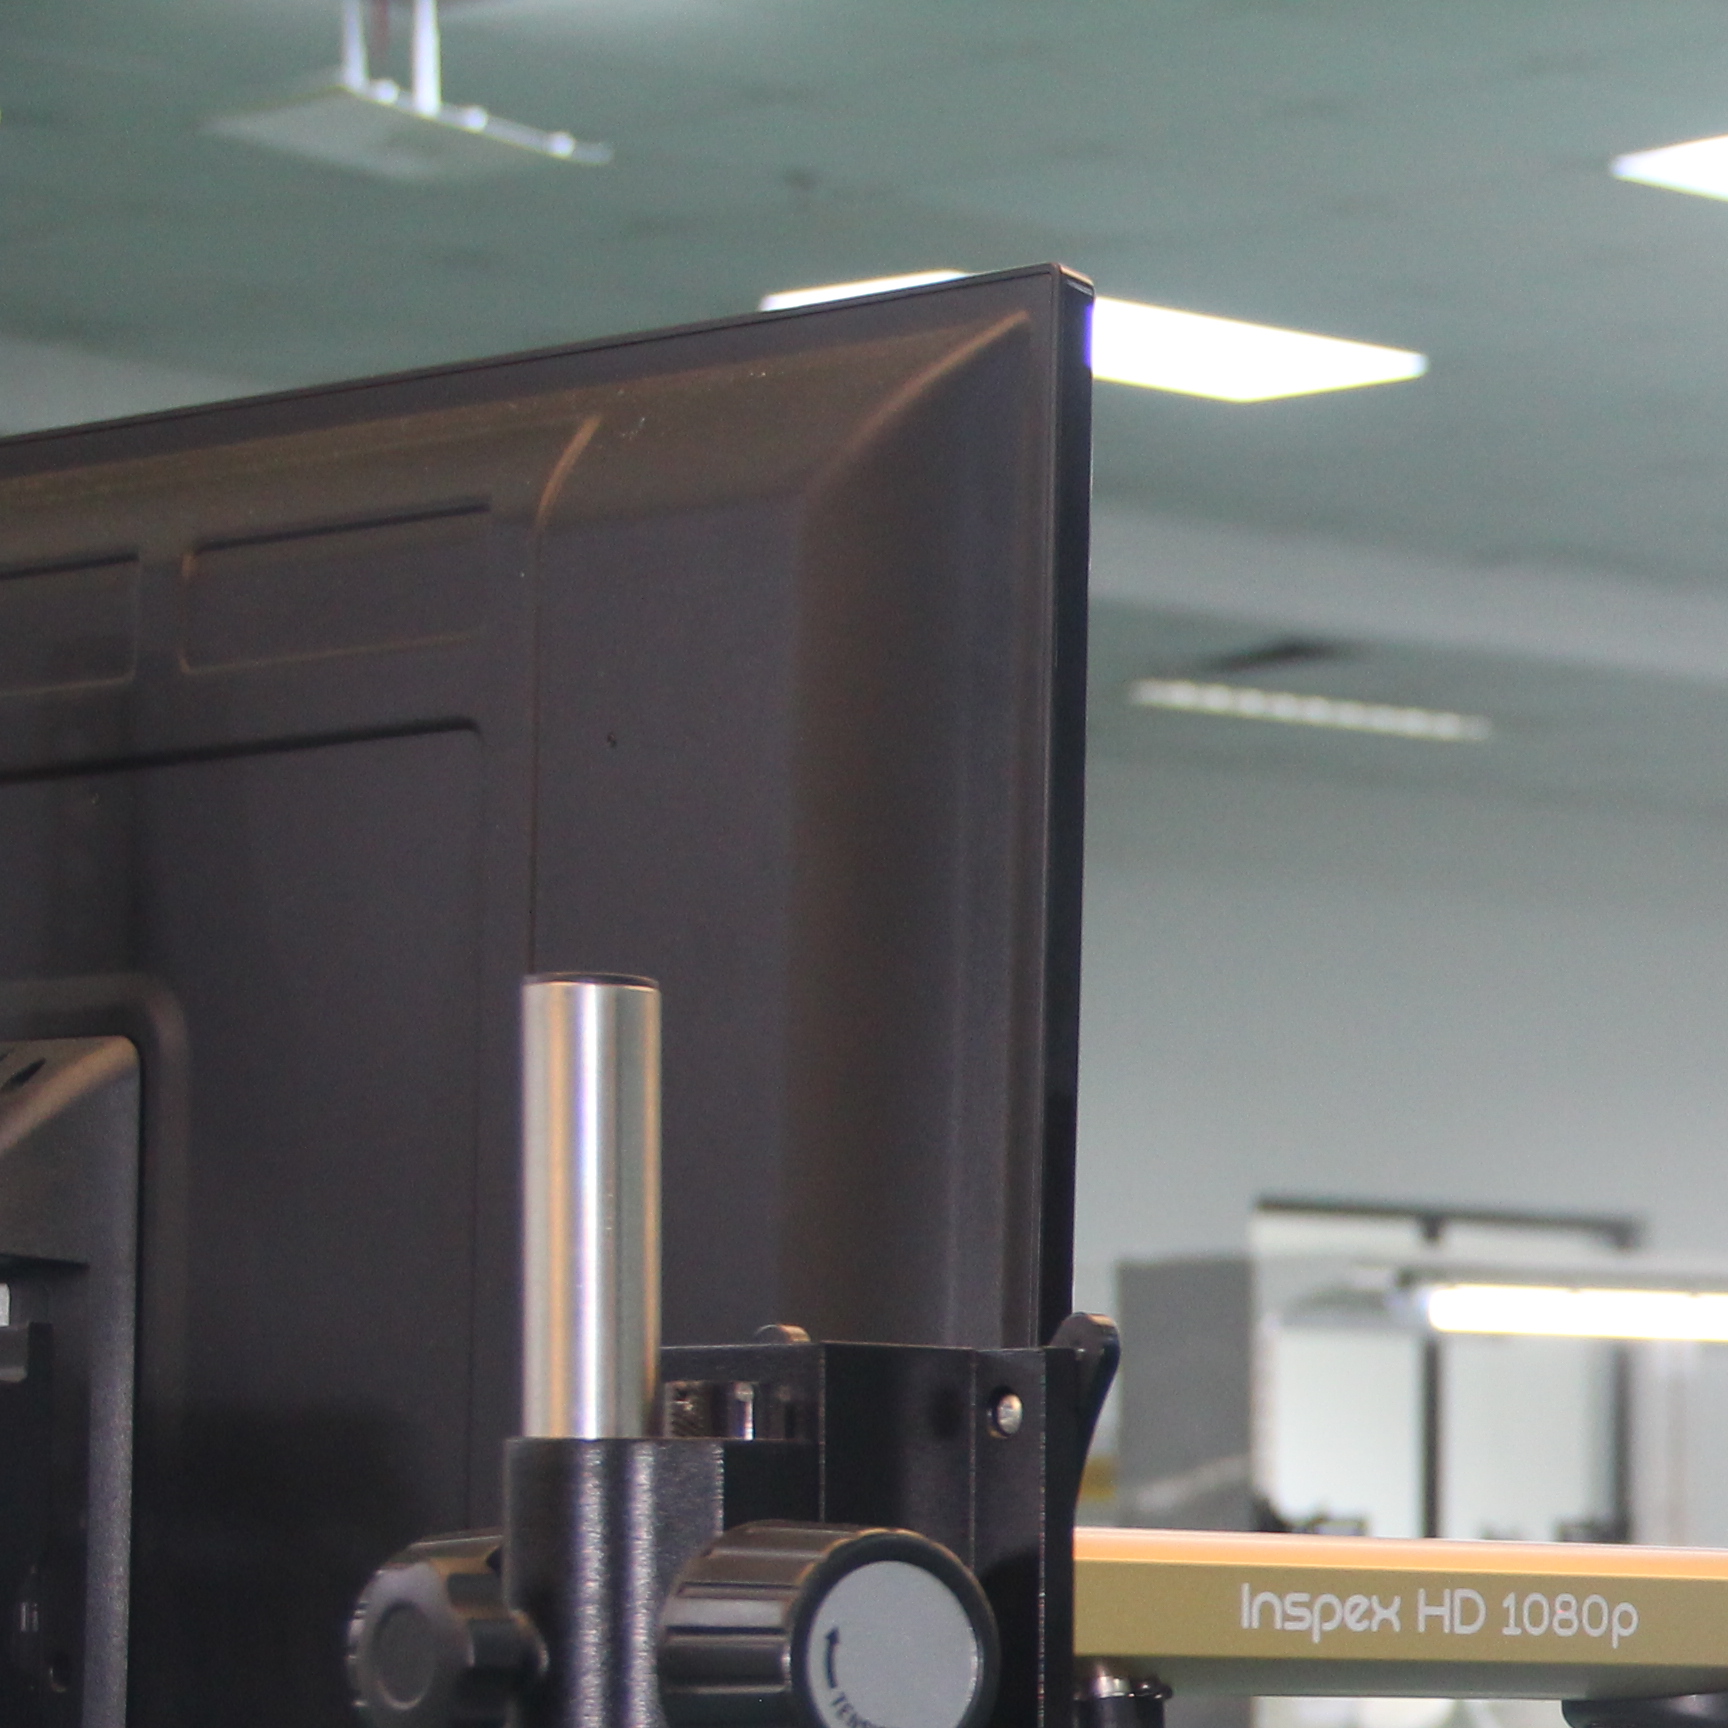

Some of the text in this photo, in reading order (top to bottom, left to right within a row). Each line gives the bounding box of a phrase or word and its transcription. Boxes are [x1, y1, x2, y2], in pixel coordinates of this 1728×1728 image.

[1240, 1582, 1639, 1649] Inspex HD 1080p
